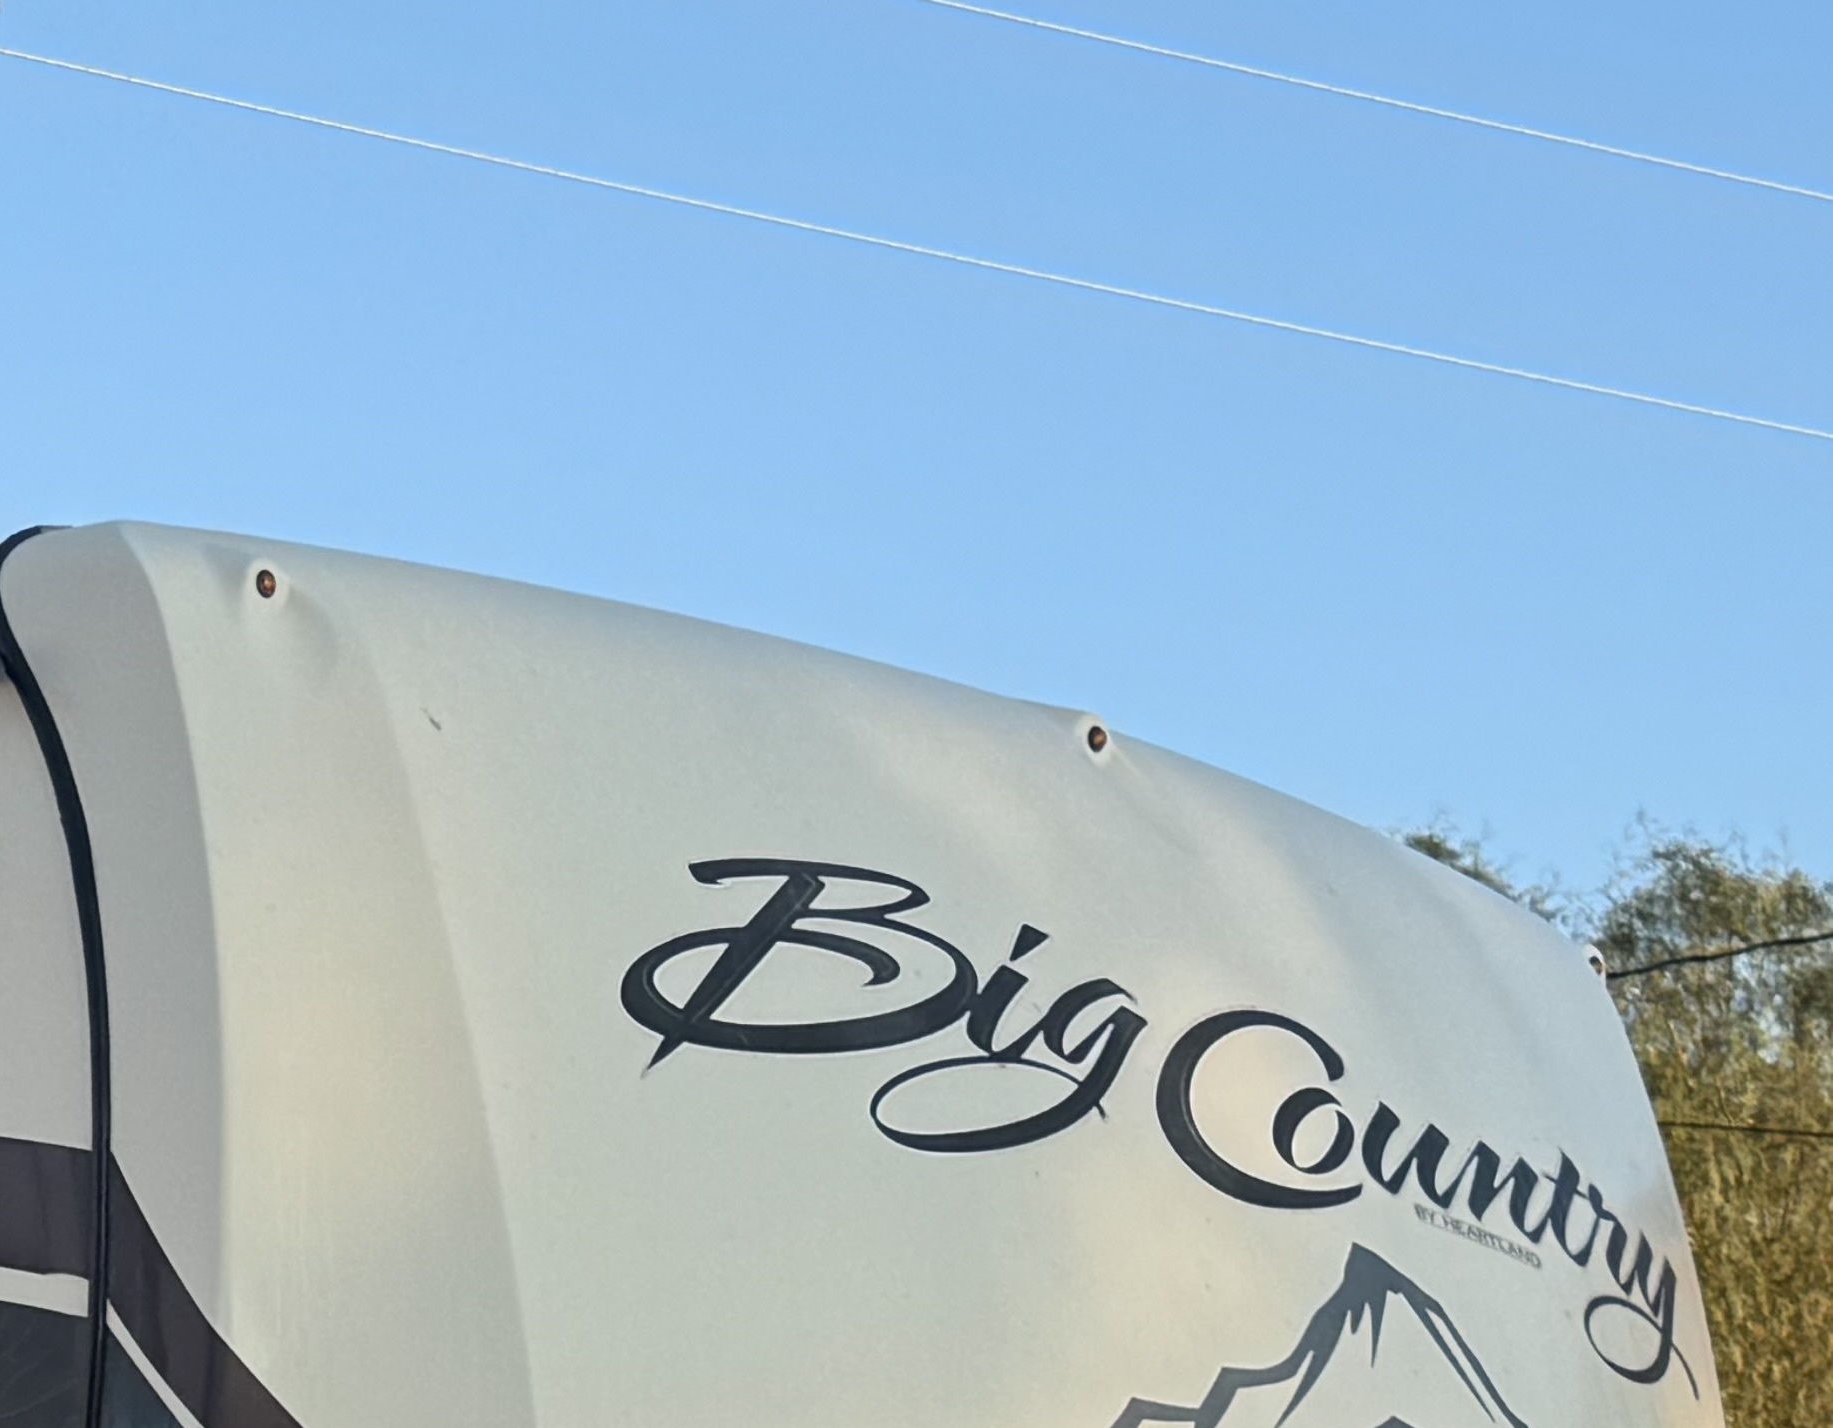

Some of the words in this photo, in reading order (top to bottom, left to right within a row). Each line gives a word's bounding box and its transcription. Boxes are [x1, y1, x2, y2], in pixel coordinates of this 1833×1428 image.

[621, 858, 1147, 1152] Big
[1155, 1009, 1701, 1400] Country
[1441, 1213, 1542, 1269] HEARTLAND
